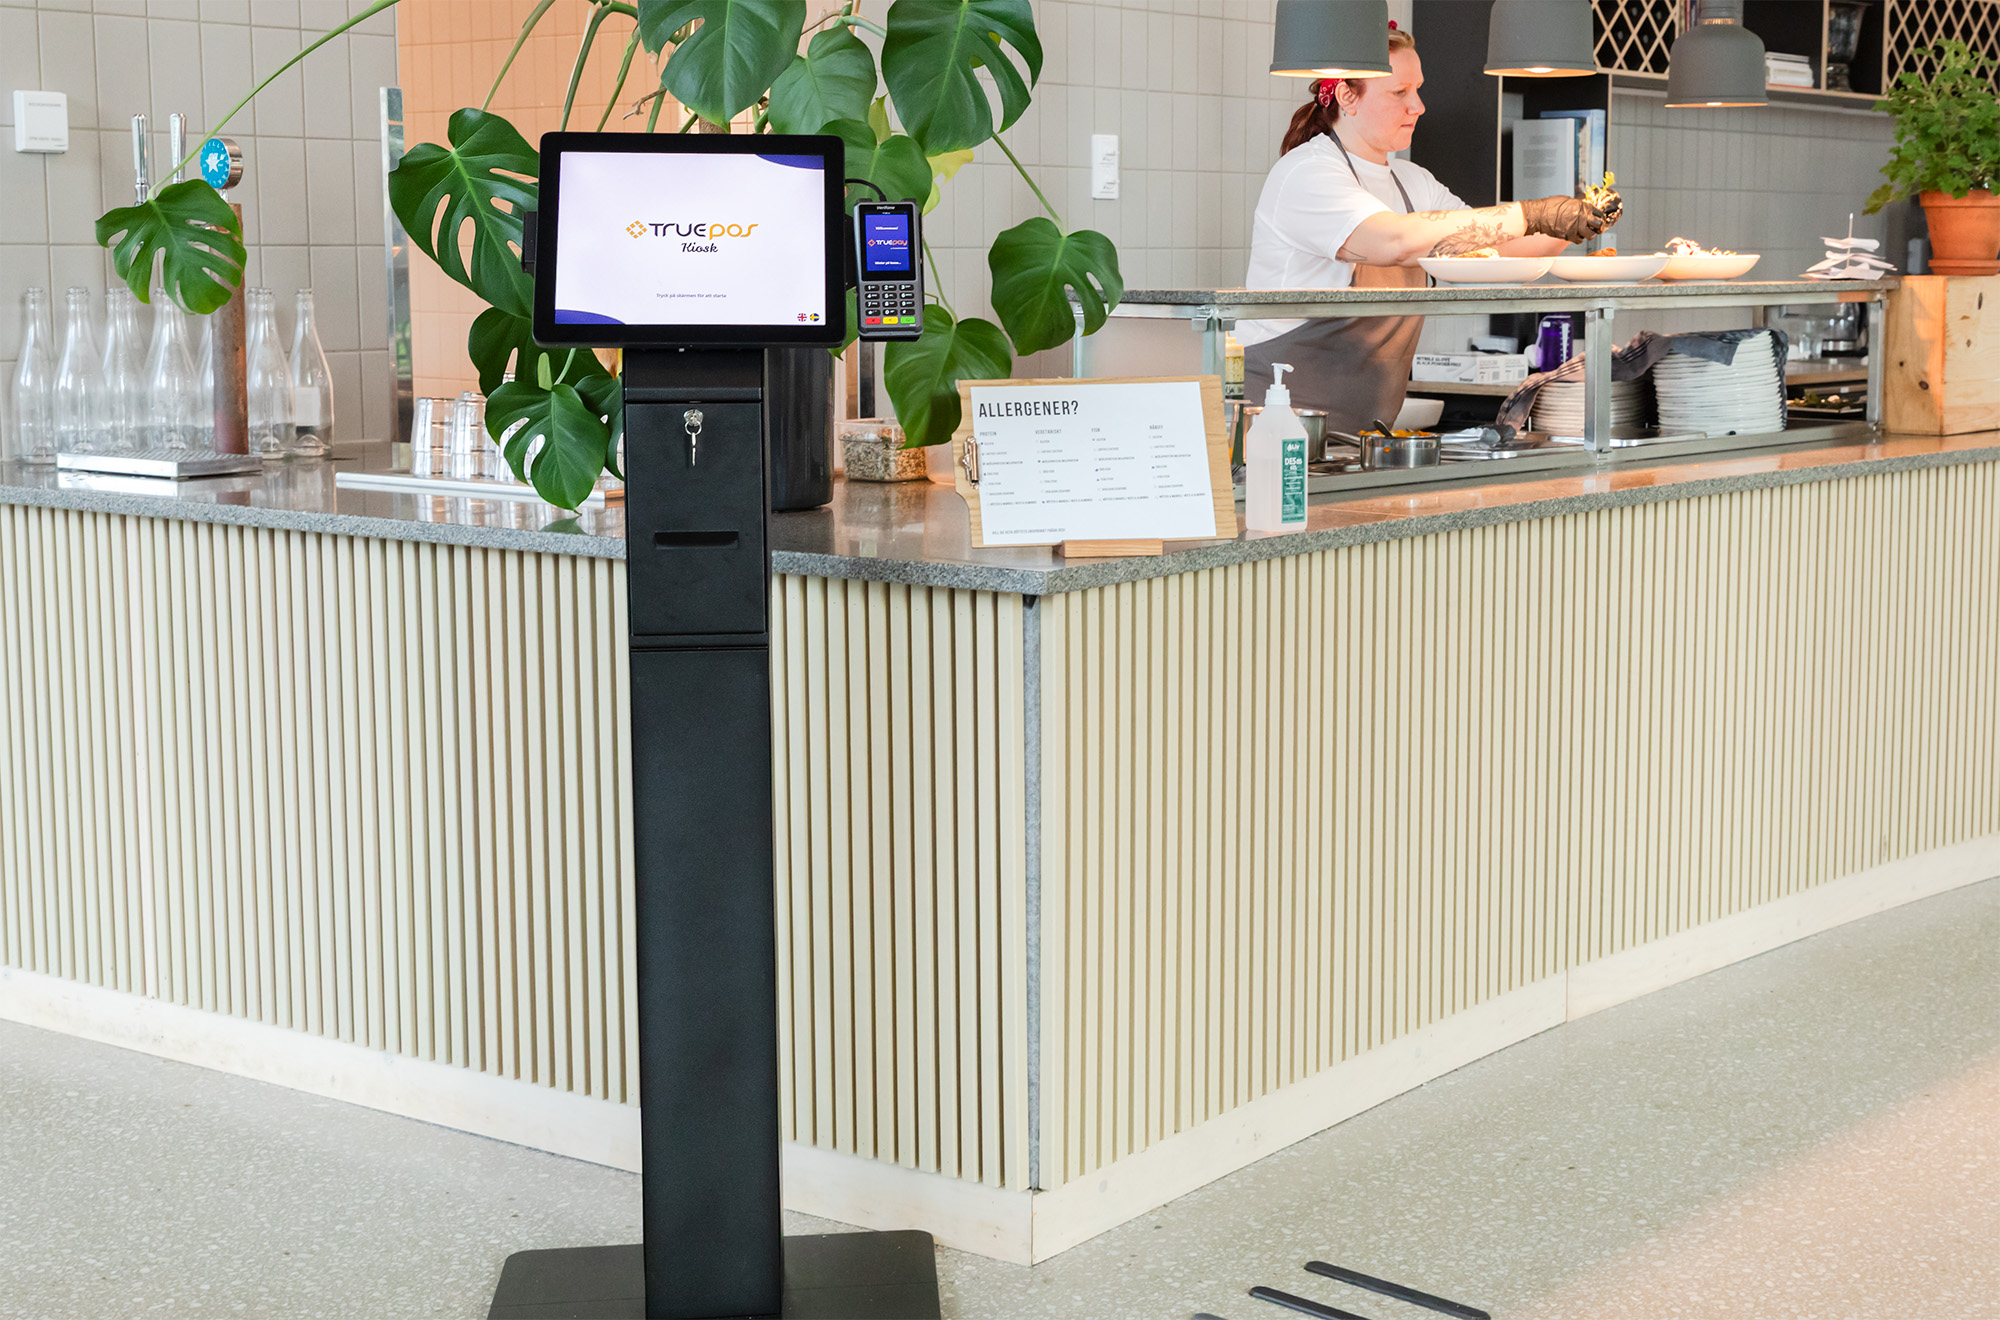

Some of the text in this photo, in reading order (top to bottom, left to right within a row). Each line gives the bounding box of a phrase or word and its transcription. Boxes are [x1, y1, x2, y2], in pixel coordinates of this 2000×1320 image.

[681, 242, 718, 253] Kiosk
[979, 400, 1078, 418] ALLERGENER?
[1285, 457, 1296, 465] DES
